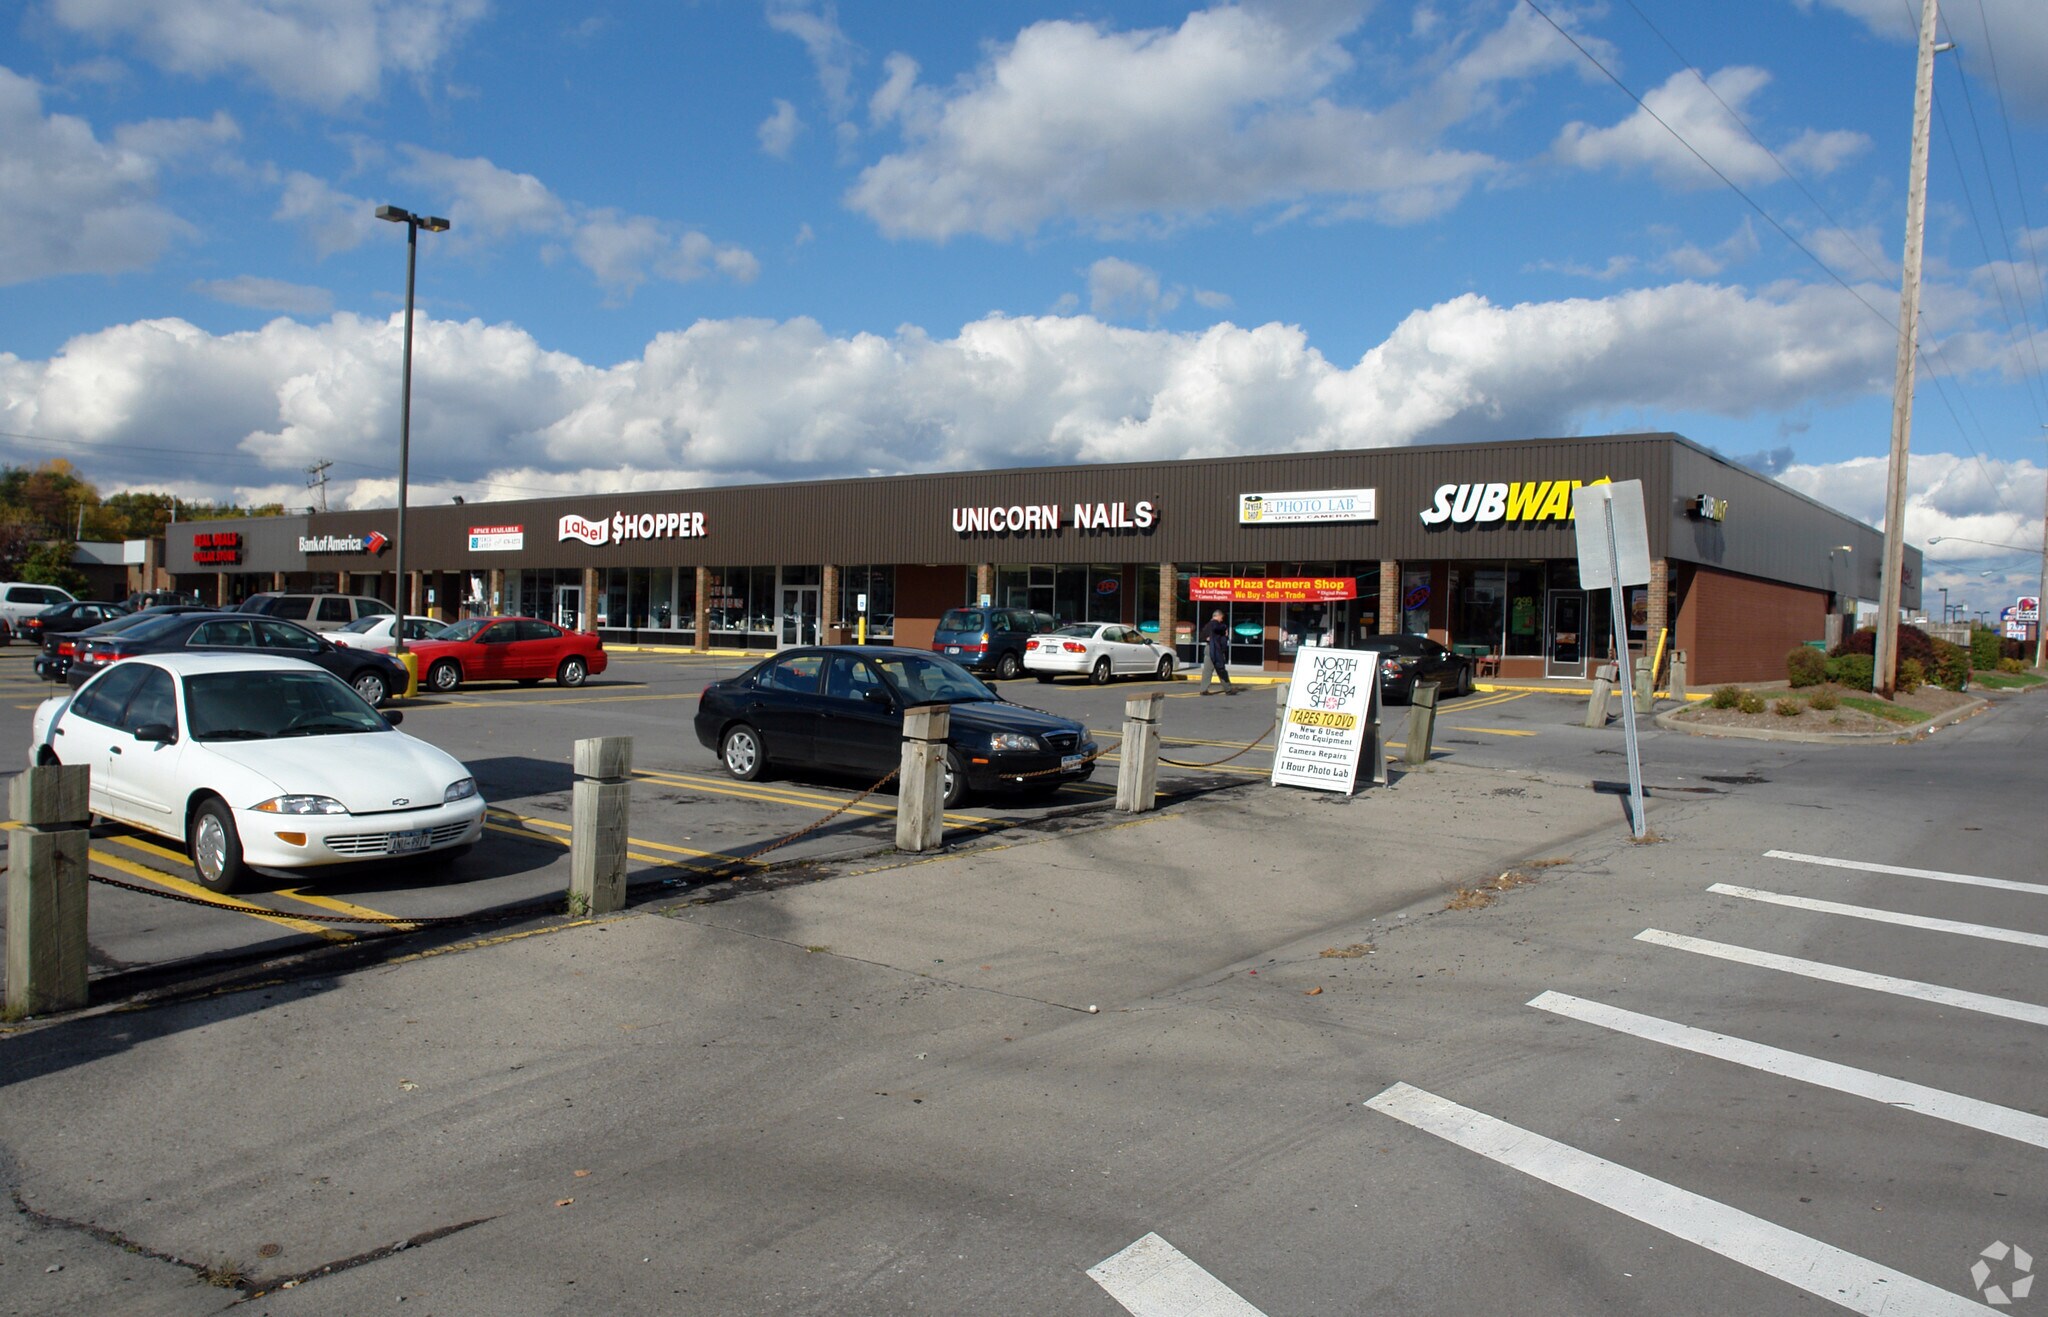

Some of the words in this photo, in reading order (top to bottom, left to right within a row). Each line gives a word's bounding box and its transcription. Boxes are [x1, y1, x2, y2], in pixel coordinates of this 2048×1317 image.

[1244, 502, 1262, 511] CAMERA
[1276, 500, 1321, 513] PHOTO
[1328, 498, 1354, 511] LAB
[1701, 494, 1728, 521] SUBWAY
[952, 505, 1058, 532] UNICORN
[1074, 501, 1153, 528] NAILS
[565, 519, 602, 541] Label
[193, 534, 211, 547] REAL
[213, 531, 237, 546] DEALS
[299, 535, 319, 552] Bank
[319, 534, 328, 551] of
[328, 533, 363, 551] America
[1199, 579, 1230, 588] North
[1234, 579, 1263, 588] Plaza
[1266, 579, 1310, 589] Camera
[1314, 579, 1344, 590] Shop
[1247, 591, 1260, 600] Buy
[1285, 591, 1306, 599] Trade
[1313, 656, 1358, 671] NORTH
[1315, 669, 1351, 684] PLAZA
[1306, 681, 1356, 698] CAMERA
[1309, 695, 1346, 709] SHOP
[1292, 710, 1320, 724] TAPES
[1322, 713, 1334, 725] TO
[1335, 715, 1354, 728] DVD
[1289, 732, 1310, 740] Photo
[1312, 735, 1352, 745] Equipment
[1300, 726, 1316, 734] New
[1325, 728, 1344, 737] Used
[1288, 747, 1316, 756] Camera
[1319, 751, 1347, 760] Repairs
[1286, 762, 1305, 772] Hour
[1307, 765, 1330, 776] Photo
[1333, 768, 1349, 778] Lab
